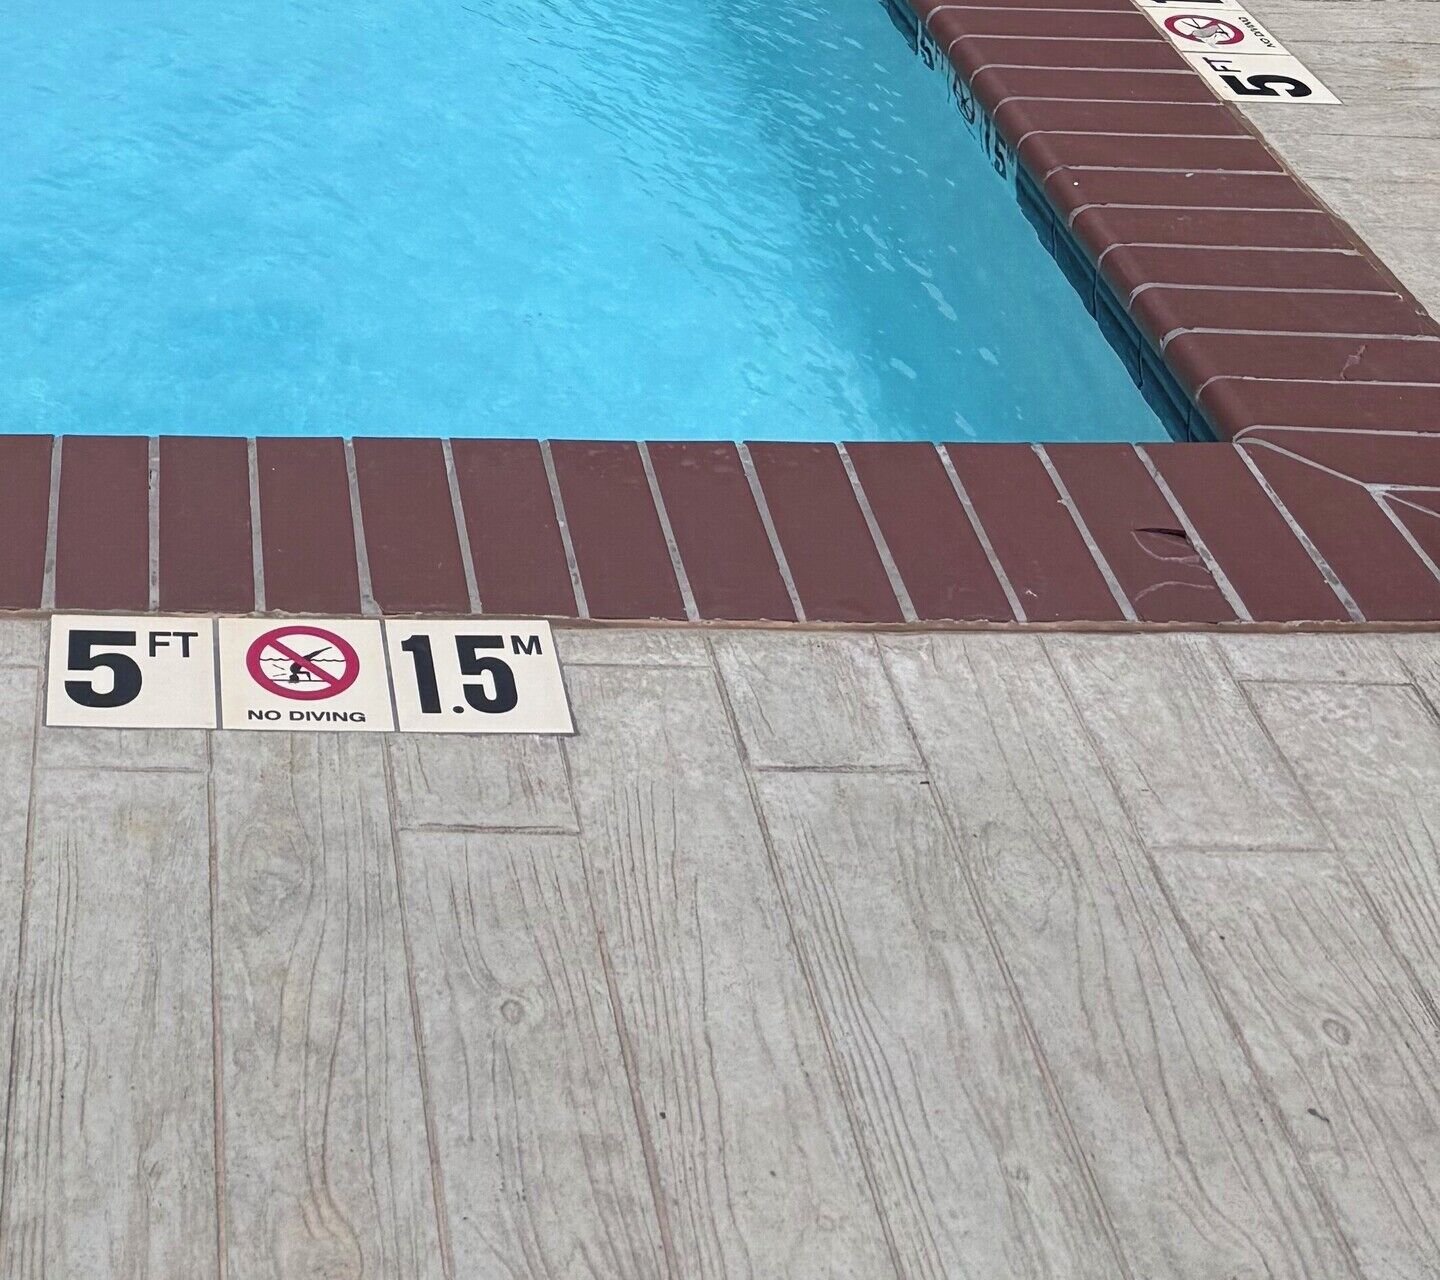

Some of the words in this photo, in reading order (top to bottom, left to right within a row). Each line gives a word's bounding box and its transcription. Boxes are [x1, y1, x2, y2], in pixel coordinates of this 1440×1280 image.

[1202, 56, 1242, 73] FT
[1219, 74, 1312, 98] 5
[64, 629, 143, 708] 5
[148, 631, 199, 658] FT
[401, 634, 518, 714] 1.5
[512, 635, 543, 655] M
[247, 709, 282, 722] NO
[289, 710, 366, 723] DIVING
